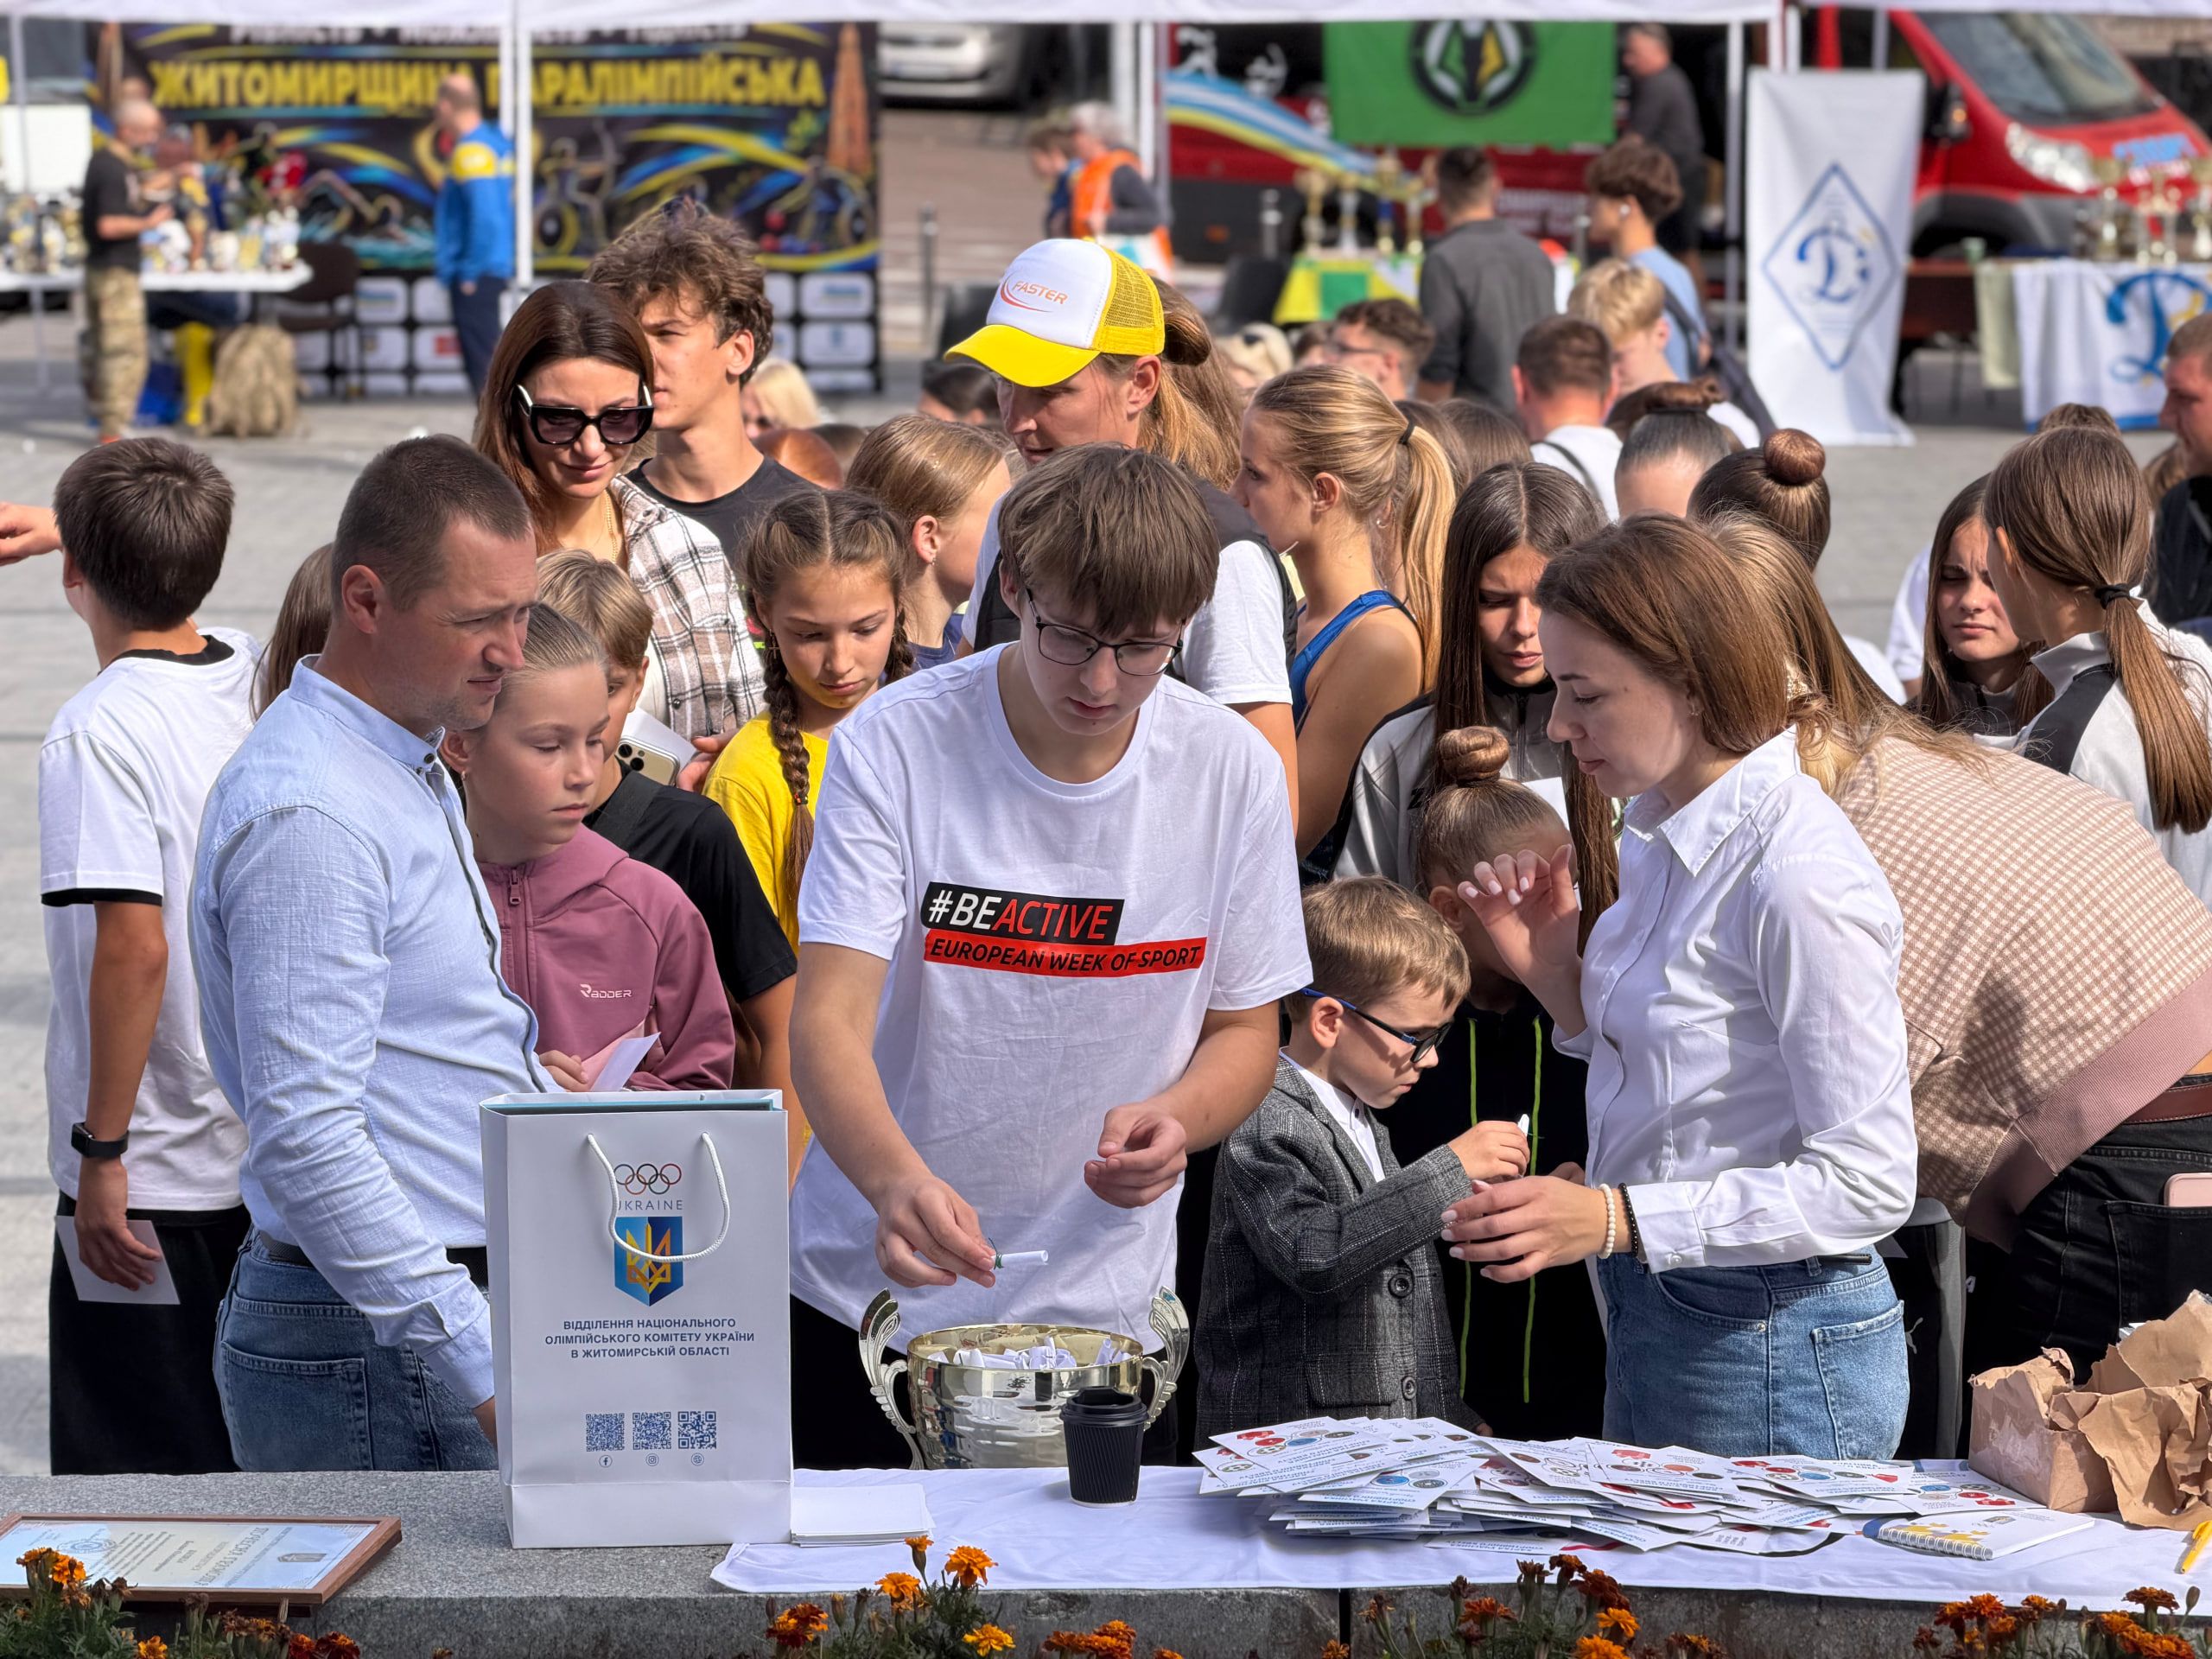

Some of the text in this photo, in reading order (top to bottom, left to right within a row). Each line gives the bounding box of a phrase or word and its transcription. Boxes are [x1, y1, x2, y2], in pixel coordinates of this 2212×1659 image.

[1012, 281, 1068, 304] FASTER
[929, 890, 1113, 939] #BEACTIVE
[931, 938, 1201, 971] EUROPEAN WEEK OF SPORT
[563, 1319, 736, 1331] ВІДДІЛЕННЯ НАЦІОНАЛЬНОГО
[545, 1332, 754, 1344] ОЛІМПІЙСЬКОГО КОМІТЕТУ УКРАЇНИ
[571, 1346, 729, 1358] В ЖИТОМИРСЬКІЙ ОБЛАСТІ
